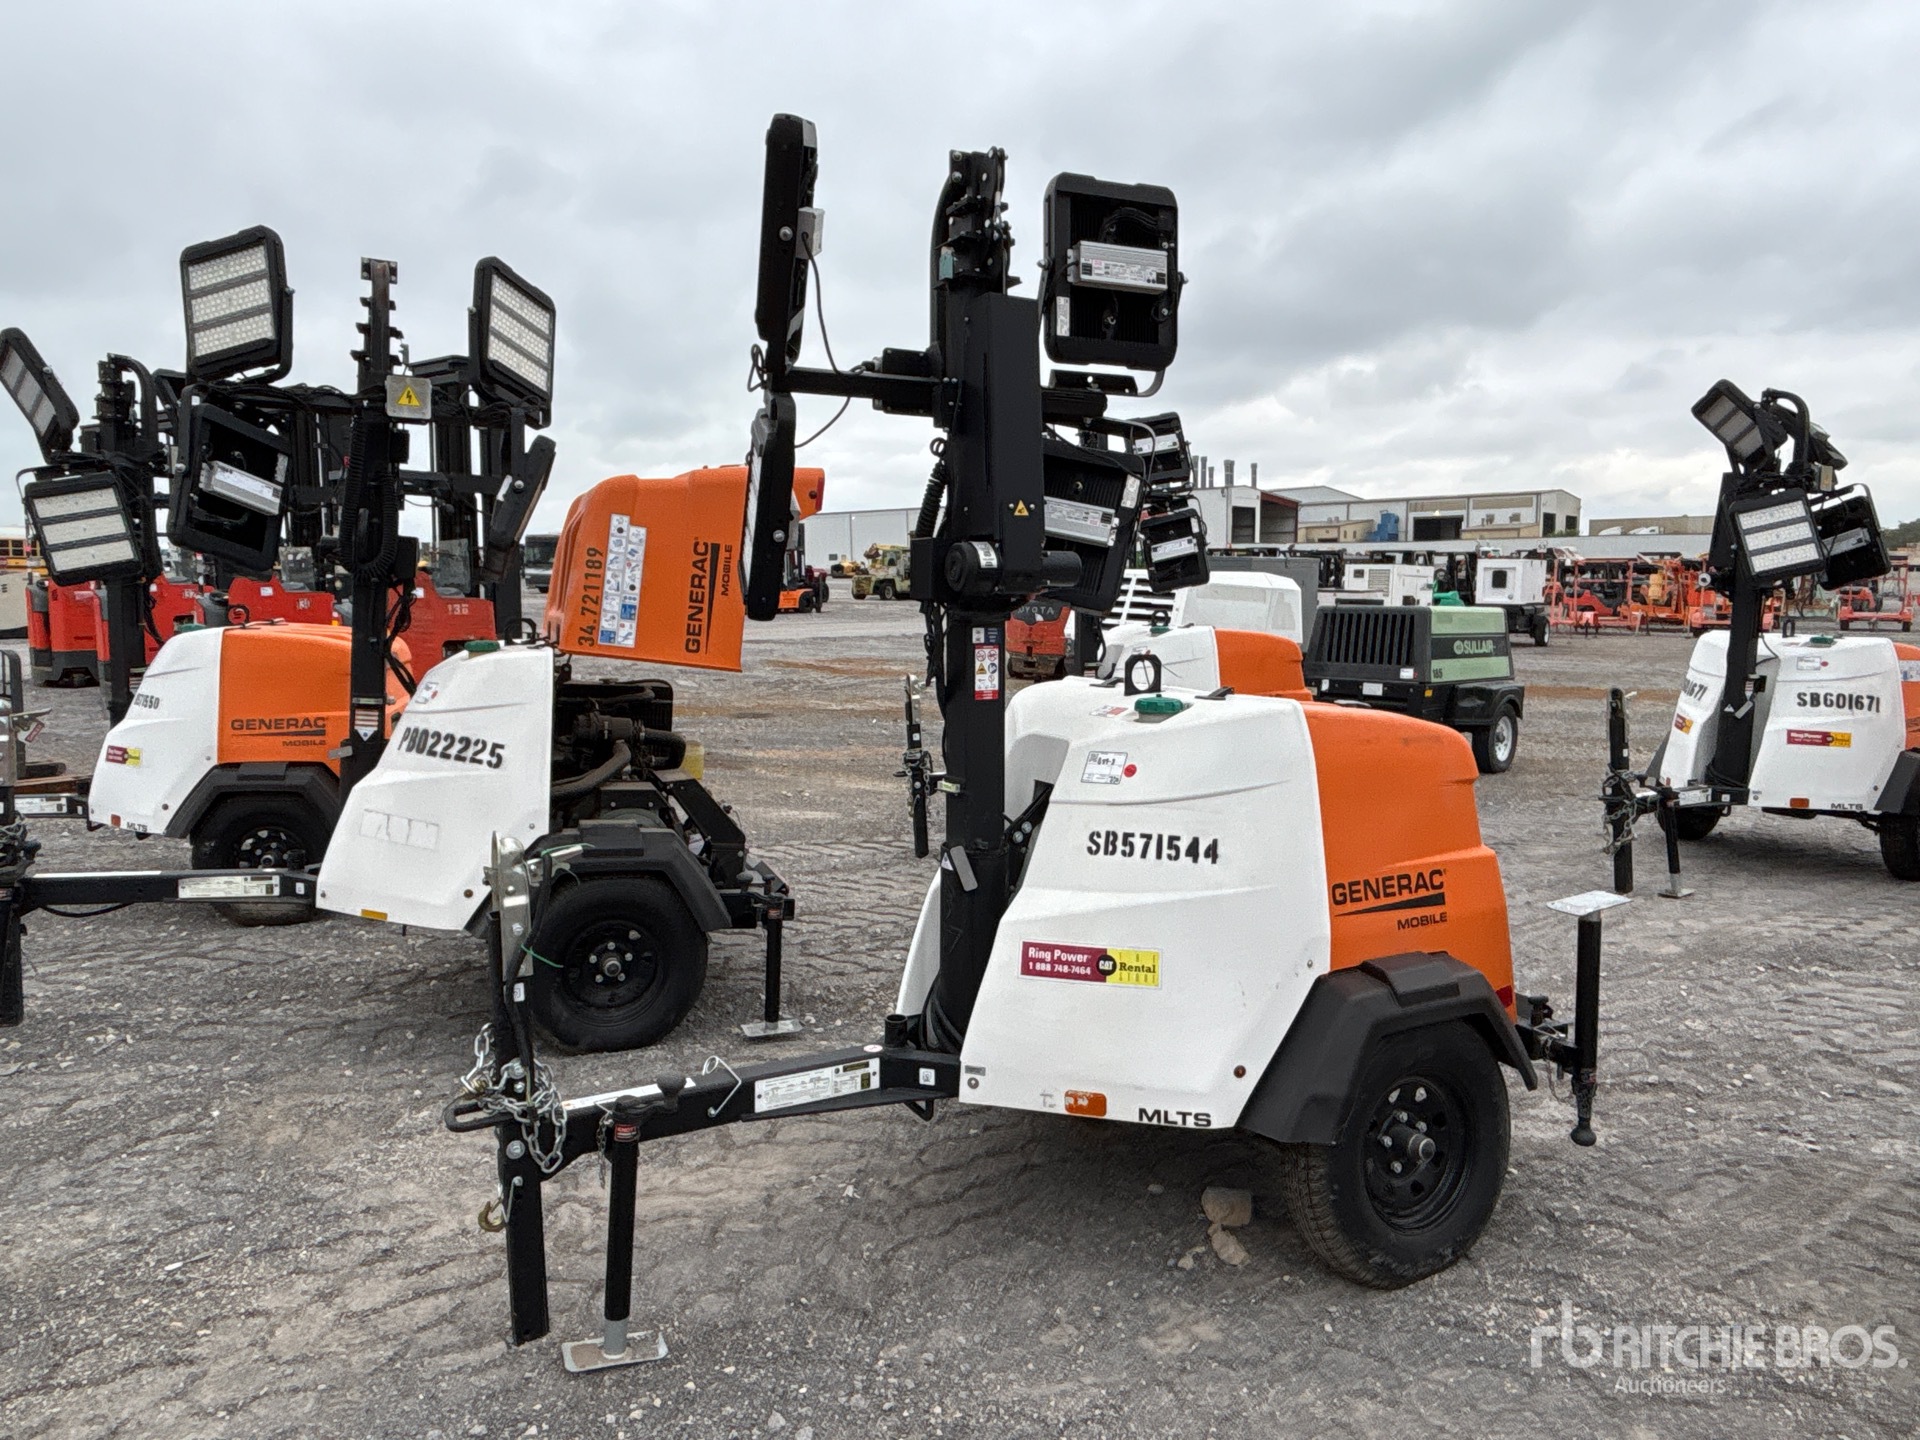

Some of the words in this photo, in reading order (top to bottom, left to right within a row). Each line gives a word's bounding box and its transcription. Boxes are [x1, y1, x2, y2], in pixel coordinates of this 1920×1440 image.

[721, 544, 733, 597] MOBILE
[578, 547, 604, 647] 34.721189
[685, 541, 709, 654] GENERAC
[1464, 639, 1494, 654] SULLAIR
[1796, 691, 1881, 713] SB601671
[230, 716, 326, 731] GENERAC
[282, 739, 327, 747] MOBILE
[398, 726, 505, 769] PB022225
[1087, 830, 1219, 865] SB571544
[1331, 869, 1445, 906] GENERAC
[1397, 911, 1448, 931] MOBILE
[1028, 947, 1051, 962] Ring
[1053, 948, 1089, 963] Power
[1028, 961, 1034, 970] 1
[1053, 963, 1092, 976] 748-7464
[1099, 959, 1114, 971] CAT
[1118, 961, 1156, 974] Rental
[1137, 1107, 1213, 1128] MLTS
